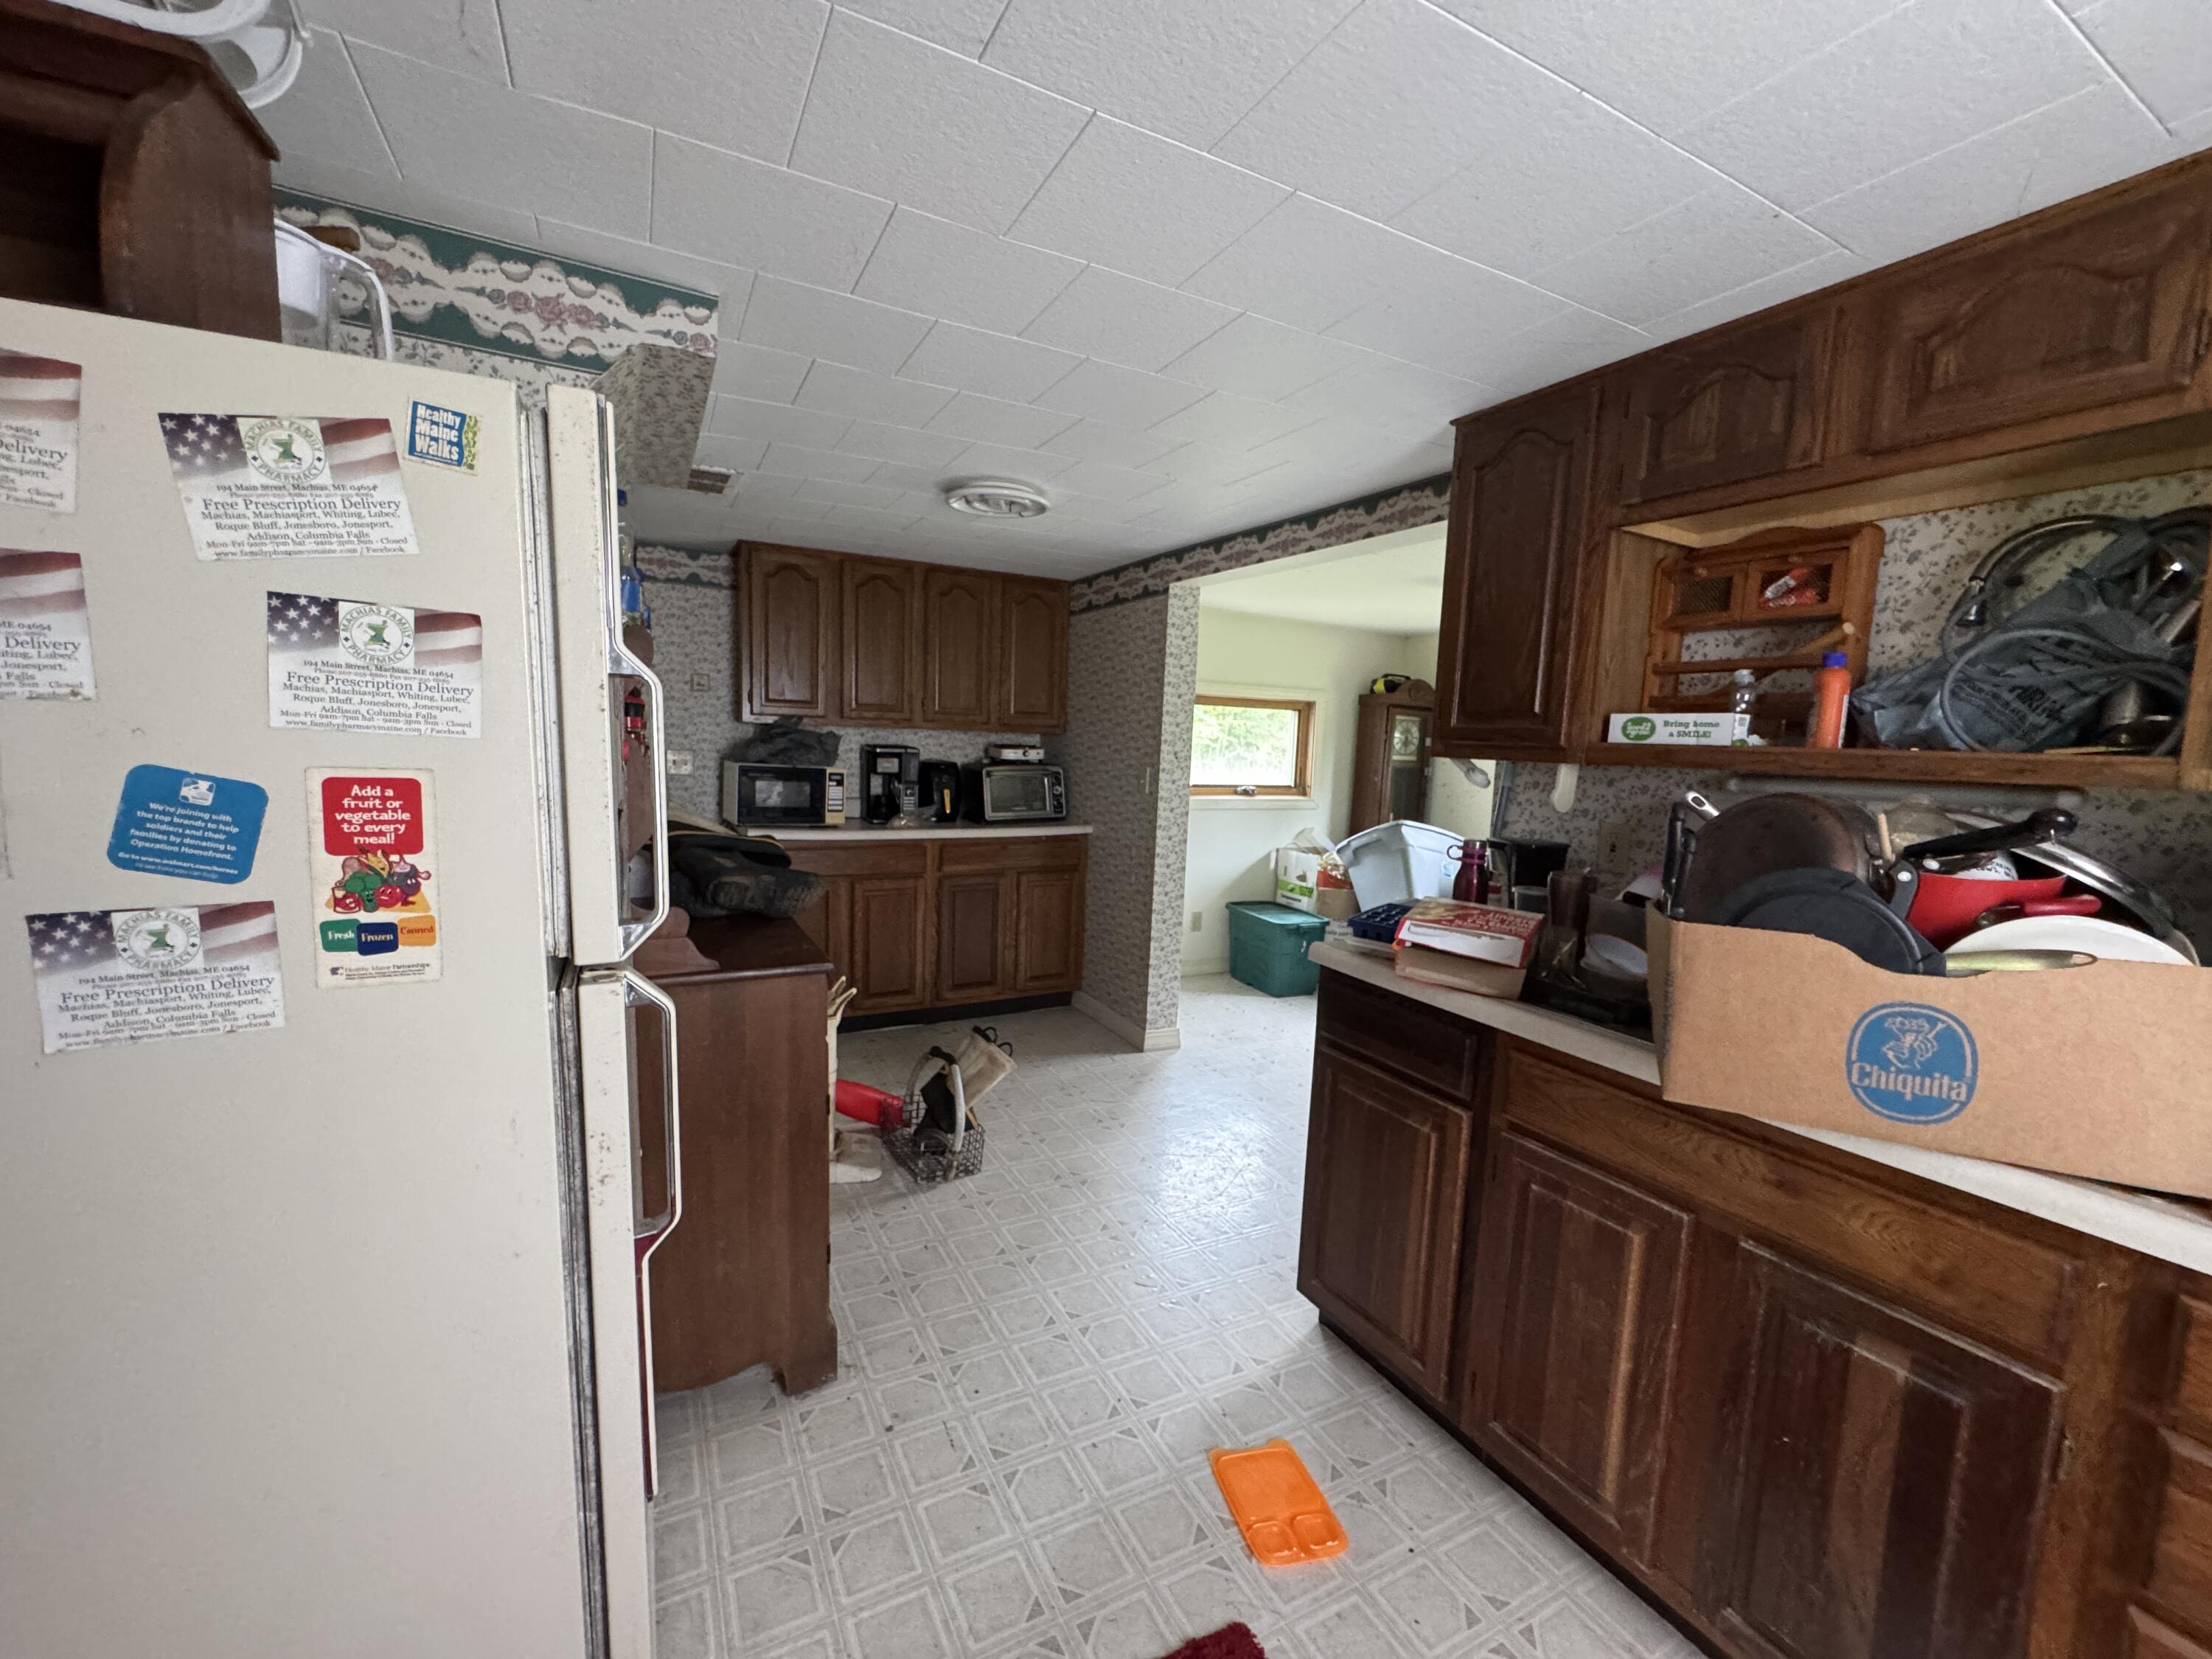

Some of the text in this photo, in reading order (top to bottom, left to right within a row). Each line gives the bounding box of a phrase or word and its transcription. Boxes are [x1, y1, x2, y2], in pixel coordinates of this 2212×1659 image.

[417, 404, 461, 429] Healthy
[415, 418, 459, 442] Maine
[0, 439, 68, 463] elivery
[415, 434, 459, 460] Walks
[235, 484, 259, 492] Main
[202, 498, 400, 512] Free Prescription Delivery
[201, 511, 250, 520] Machias,
[322, 510, 366, 519] Whiting,
[369, 509, 400, 518] Lubec,
[215, 522, 249, 532] Roque
[296, 531, 344, 540] Columbia
[347, 531, 371, 539] Falls
[341, 606, 412, 639] MACHIAS FAMILY
[5, 636, 81, 654] Delivery
[348, 644, 406, 664] PHARMACY
[321, 661, 343, 669] Main
[345, 662, 372, 671] Street,
[375, 665, 411, 675] Machias,
[413, 668, 428, 676] ME
[429, 670, 453, 679] 04654
[287, 671, 474, 698] Free Prescription Delivery
[283, 683, 470, 705] Machias, Machiasport, Whiting, Lubec,
[293, 693, 462, 713] Roque Bluff, Jonesboro, Jonesport,
[320, 705, 437, 720] Addison, Columbia Falls
[361, 713, 375, 722] Sat
[446, 720, 472, 728] Closed
[431, 728, 467, 736] Facebook
[1663, 720, 1690, 729] Bring
[351, 785, 394, 796] Add a
[341, 797, 403, 809] fruit or
[149, 802, 232, 823] We're joining with
[334, 809, 411, 824] vegetable
[136, 810, 240, 834] the top brands to help
[340, 823, 406, 834] to every
[145, 822, 228, 841] soldiers and their
[353, 832, 395, 844] meal!
[130, 829, 237, 852] families by donating to
[131, 839, 234, 860] Operation Homefront.
[327, 925, 434, 942] Fresh Frozen Canned
[98, 975, 124, 983] Main
[60, 992, 100, 1004] Free
[105, 983, 206, 1000] Prescription
[211, 977, 274, 990] Delivery
[189, 991, 234, 1001] Whiting,
[211, 1009, 236, 1018] Falls
[246, 1011, 276, 1020] Closed
[1851, 1062, 1967, 1101] Chiquita
